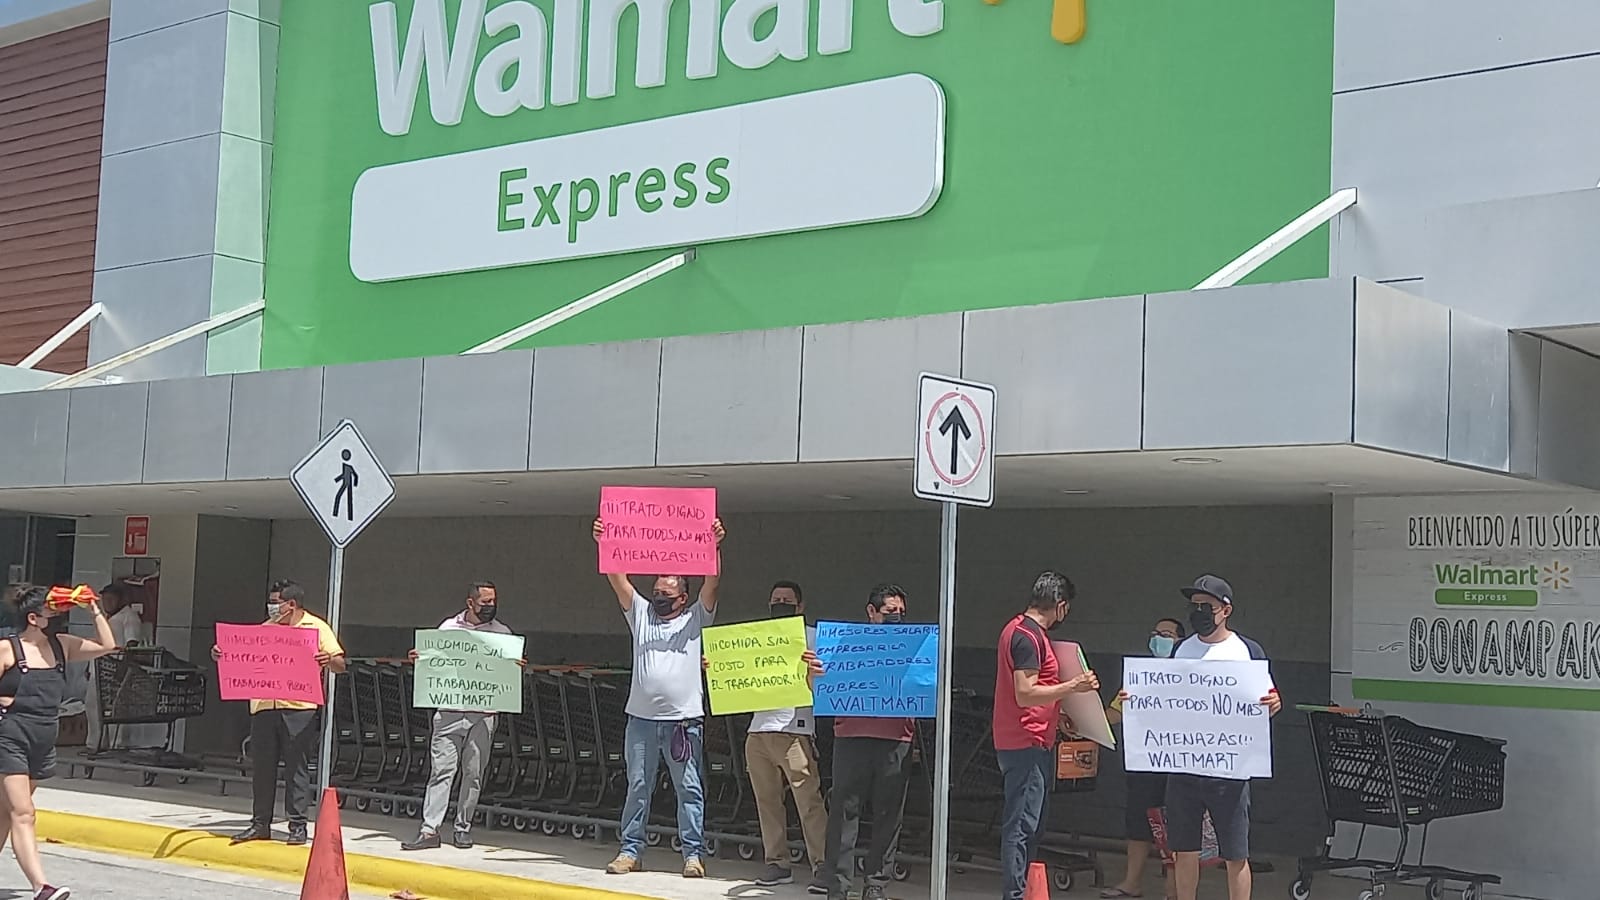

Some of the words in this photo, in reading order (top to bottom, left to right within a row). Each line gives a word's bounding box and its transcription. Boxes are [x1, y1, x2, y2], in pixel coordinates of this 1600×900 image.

[496, 156, 731, 243] Express
[666, 504, 705, 520] DIGNO
[606, 522, 637, 539] PARA
[1408, 515, 1504, 547] BIENVENIDO
[1510, 516, 1520, 546] A
[1526, 515, 1546, 547] TU
[612, 547, 706, 562] AMENAZAS!!!
[1435, 563, 1538, 585] Walmart
[1464, 591, 1507, 603] Express
[766, 636, 790, 646] SIN
[1408, 617, 1600, 679] BONAMPAK
[483, 645, 503, 659] SIN
[816, 644, 873, 656] EMPRESA
[878, 643, 906, 651] RICA
[429, 656, 467, 667] COSTO
[475, 661, 495, 671] AL
[713, 661, 745, 672] COSTO
[754, 655, 788, 668] PARA
[712, 679, 723, 690] EL
[1189, 673, 1237, 687] DIGNO
[428, 693, 495, 706] WALTMART
[829, 696, 928, 712] WALTMART
[1129, 694, 1162, 710] PARA
[1166, 698, 1208, 711] TODOS
[1212, 692, 1232, 716] NO
[1236, 701, 1263, 716] MAS
[1144, 729, 1252, 747] AMENAZAS!!!
[1148, 751, 1239, 770] WALTMART
